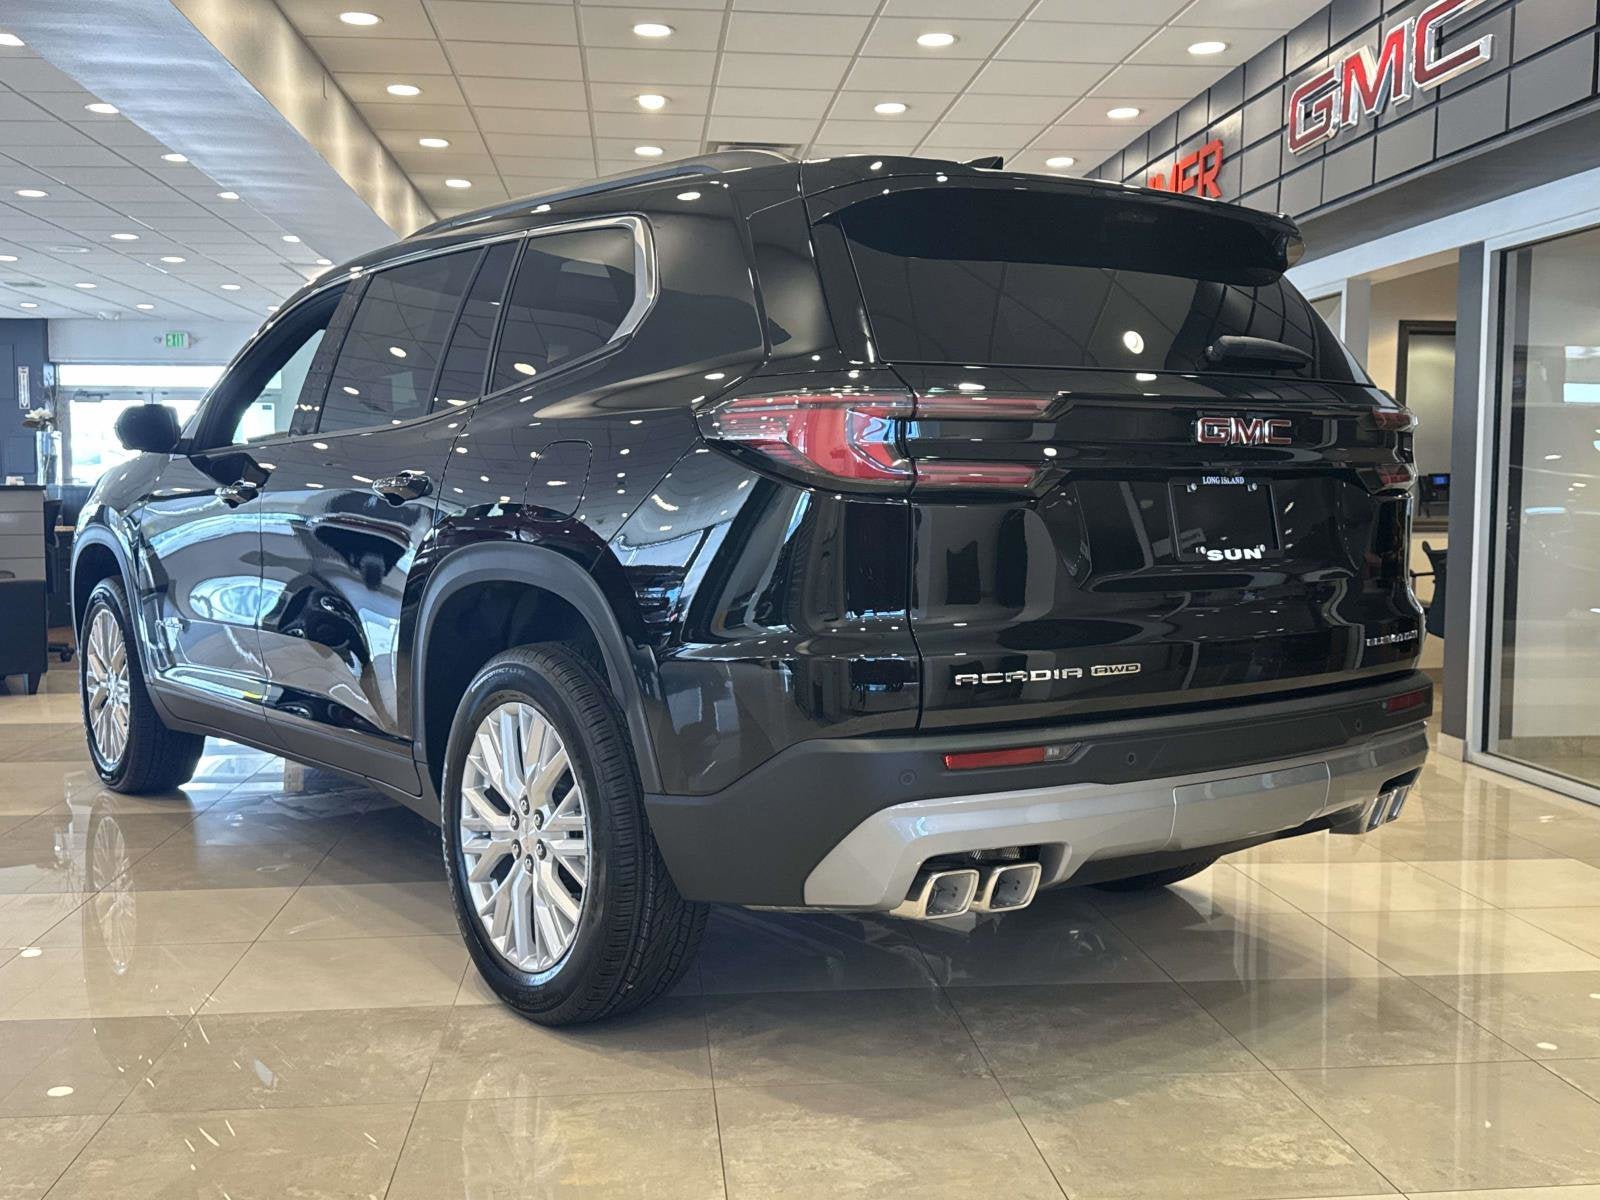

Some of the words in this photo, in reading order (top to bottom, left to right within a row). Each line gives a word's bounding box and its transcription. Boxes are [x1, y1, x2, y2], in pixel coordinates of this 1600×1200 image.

[1288, 0, 1494, 154] GMC
[165, 333, 185, 348] EXIT
[1198, 417, 1292, 446] GMC
[1202, 476, 1220, 485] LONG
[1220, 476, 1245, 485] ISLAND
[1206, 548, 1263, 561] SUN
[954, 668, 1083, 686] ACADIA
[1092, 664, 1140, 676] AWD
